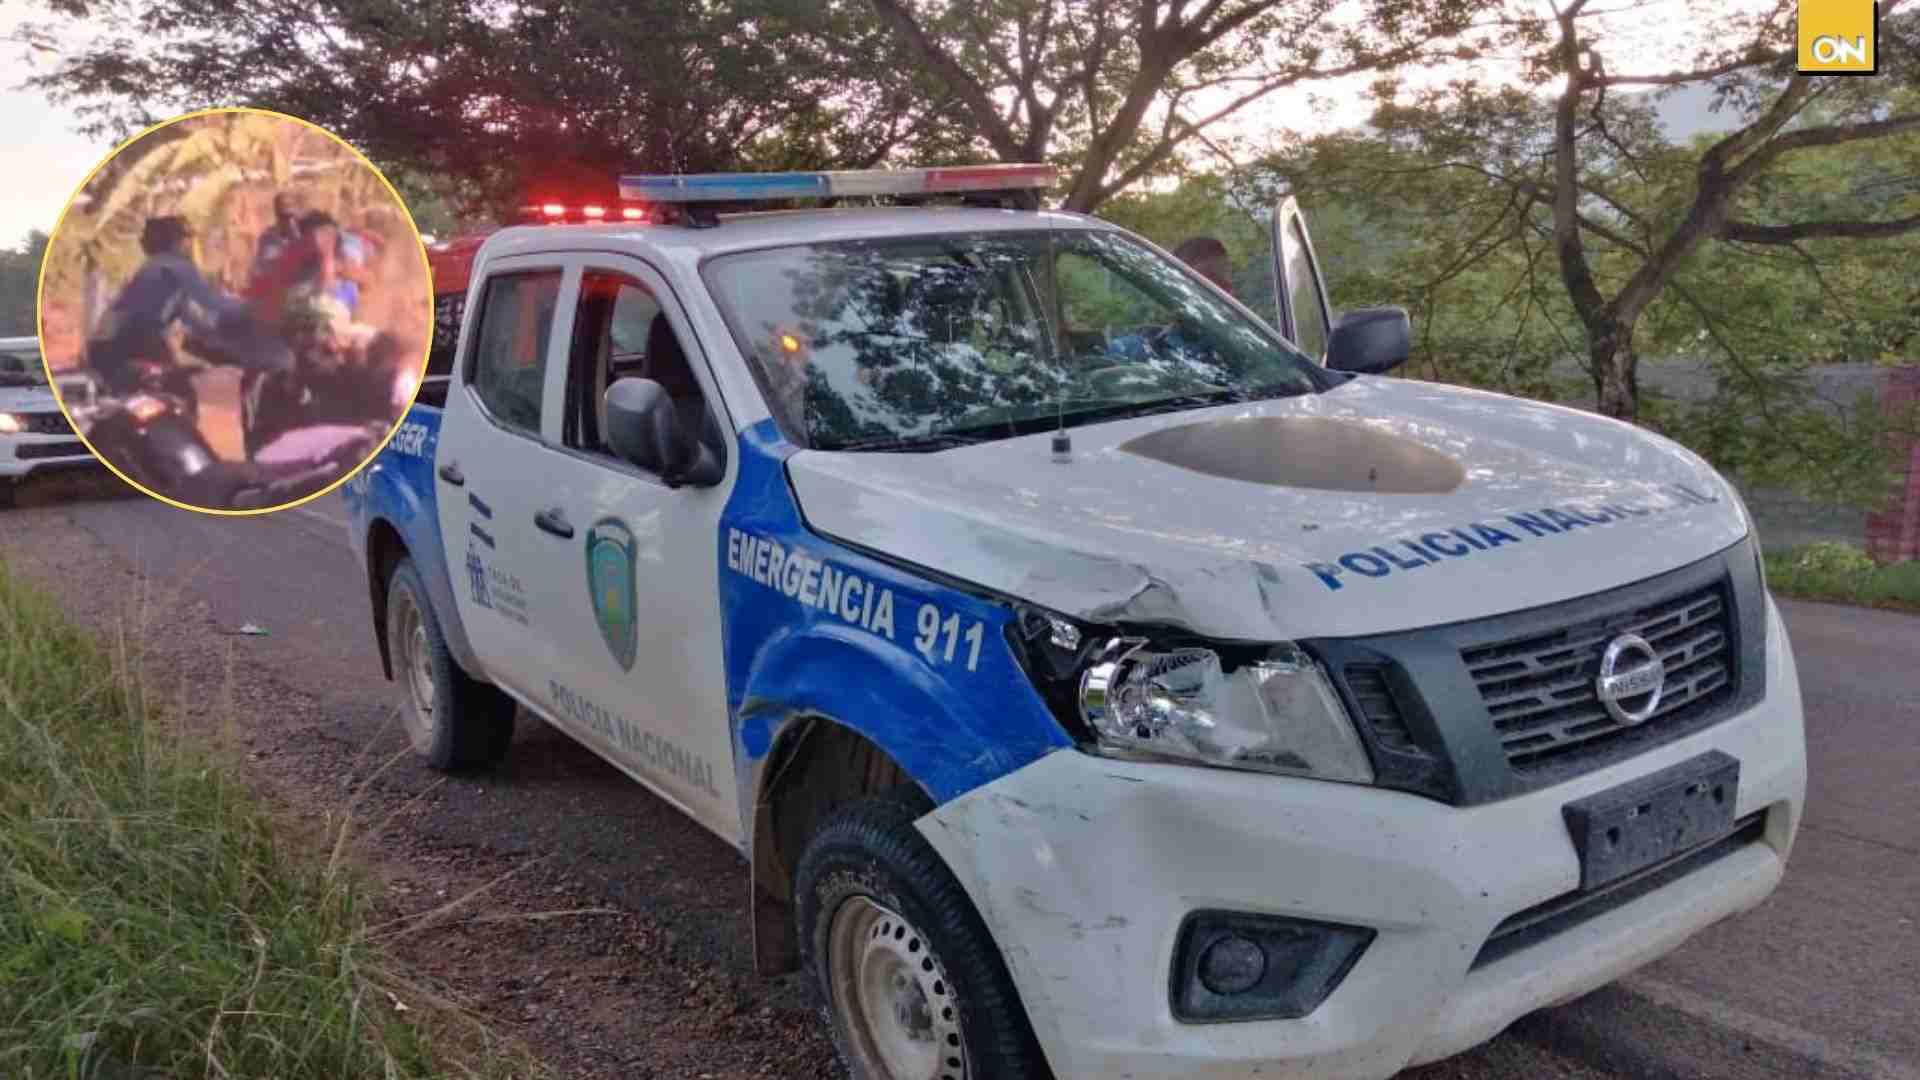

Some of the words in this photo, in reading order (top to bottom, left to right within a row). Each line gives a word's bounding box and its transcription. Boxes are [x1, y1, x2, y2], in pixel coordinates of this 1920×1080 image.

[1303, 523, 1520, 592] POLICIA
[1504, 484, 1718, 537] NACIOAL
[728, 527, 895, 640] EMERGENCIA
[914, 603, 984, 672] 911
[616, 713, 720, 798] NACIONAL
